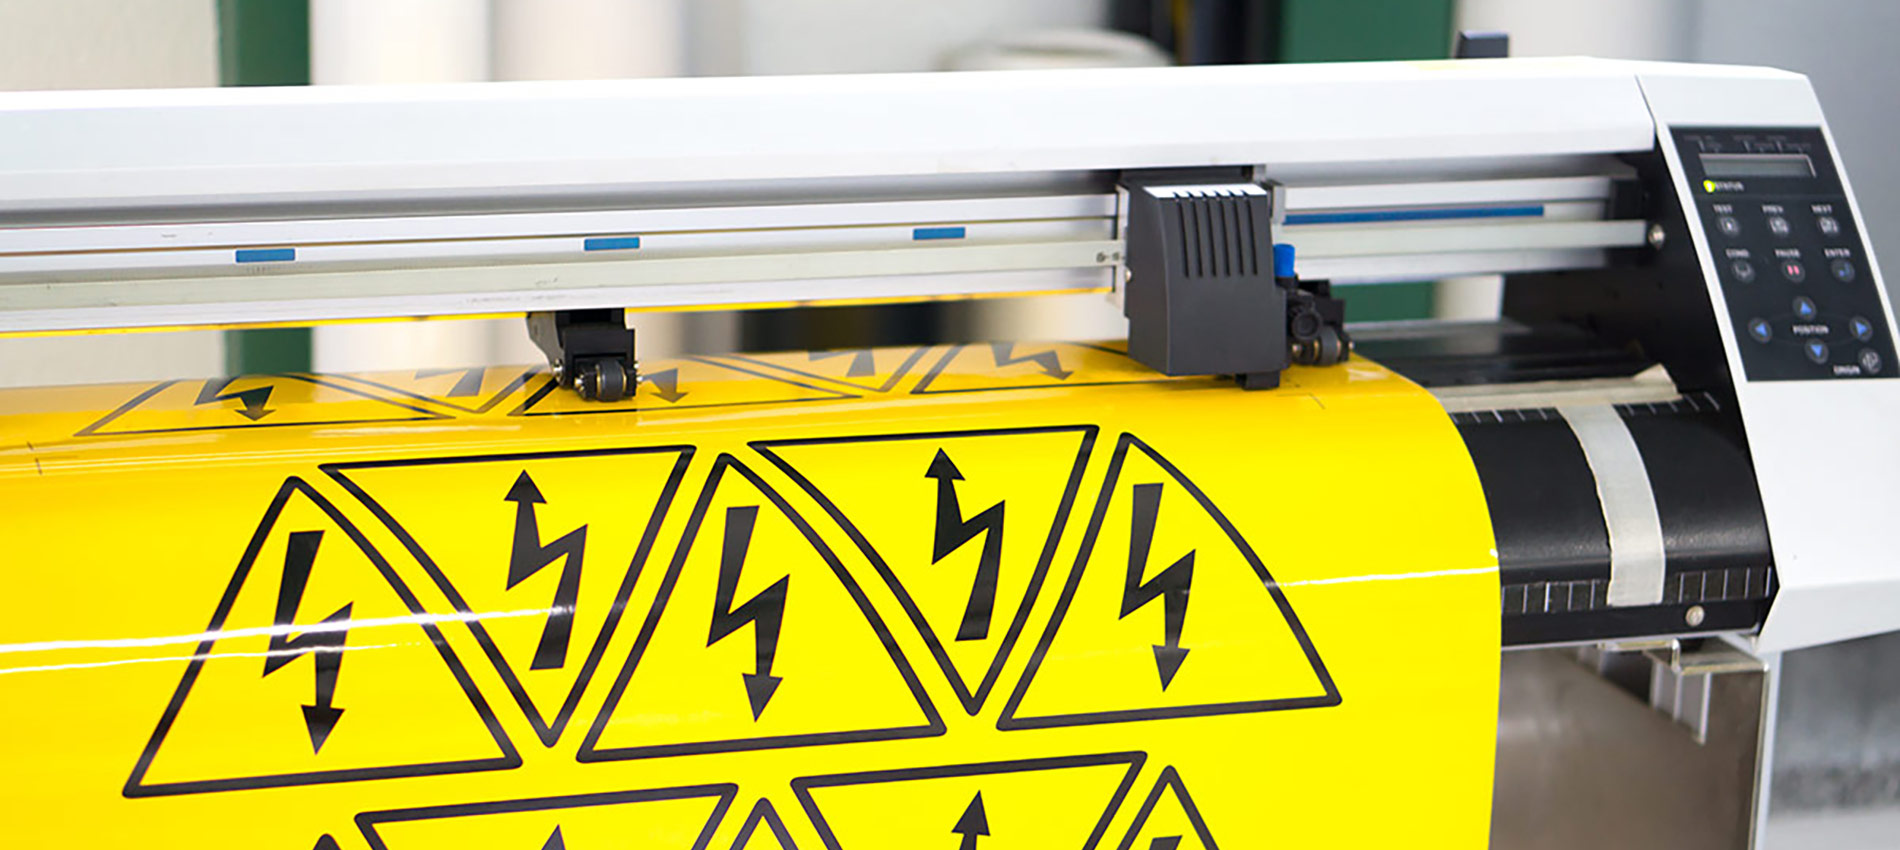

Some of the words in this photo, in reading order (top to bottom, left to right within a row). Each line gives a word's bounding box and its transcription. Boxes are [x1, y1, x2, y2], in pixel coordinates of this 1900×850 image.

[1713, 204, 1733, 213] TEST
[1811, 204, 1832, 213] NEXT
[1775, 249, 1800, 258] PAUSE
[1824, 249, 1850, 258] ENTER
[1793, 325, 1829, 334] POSITION
